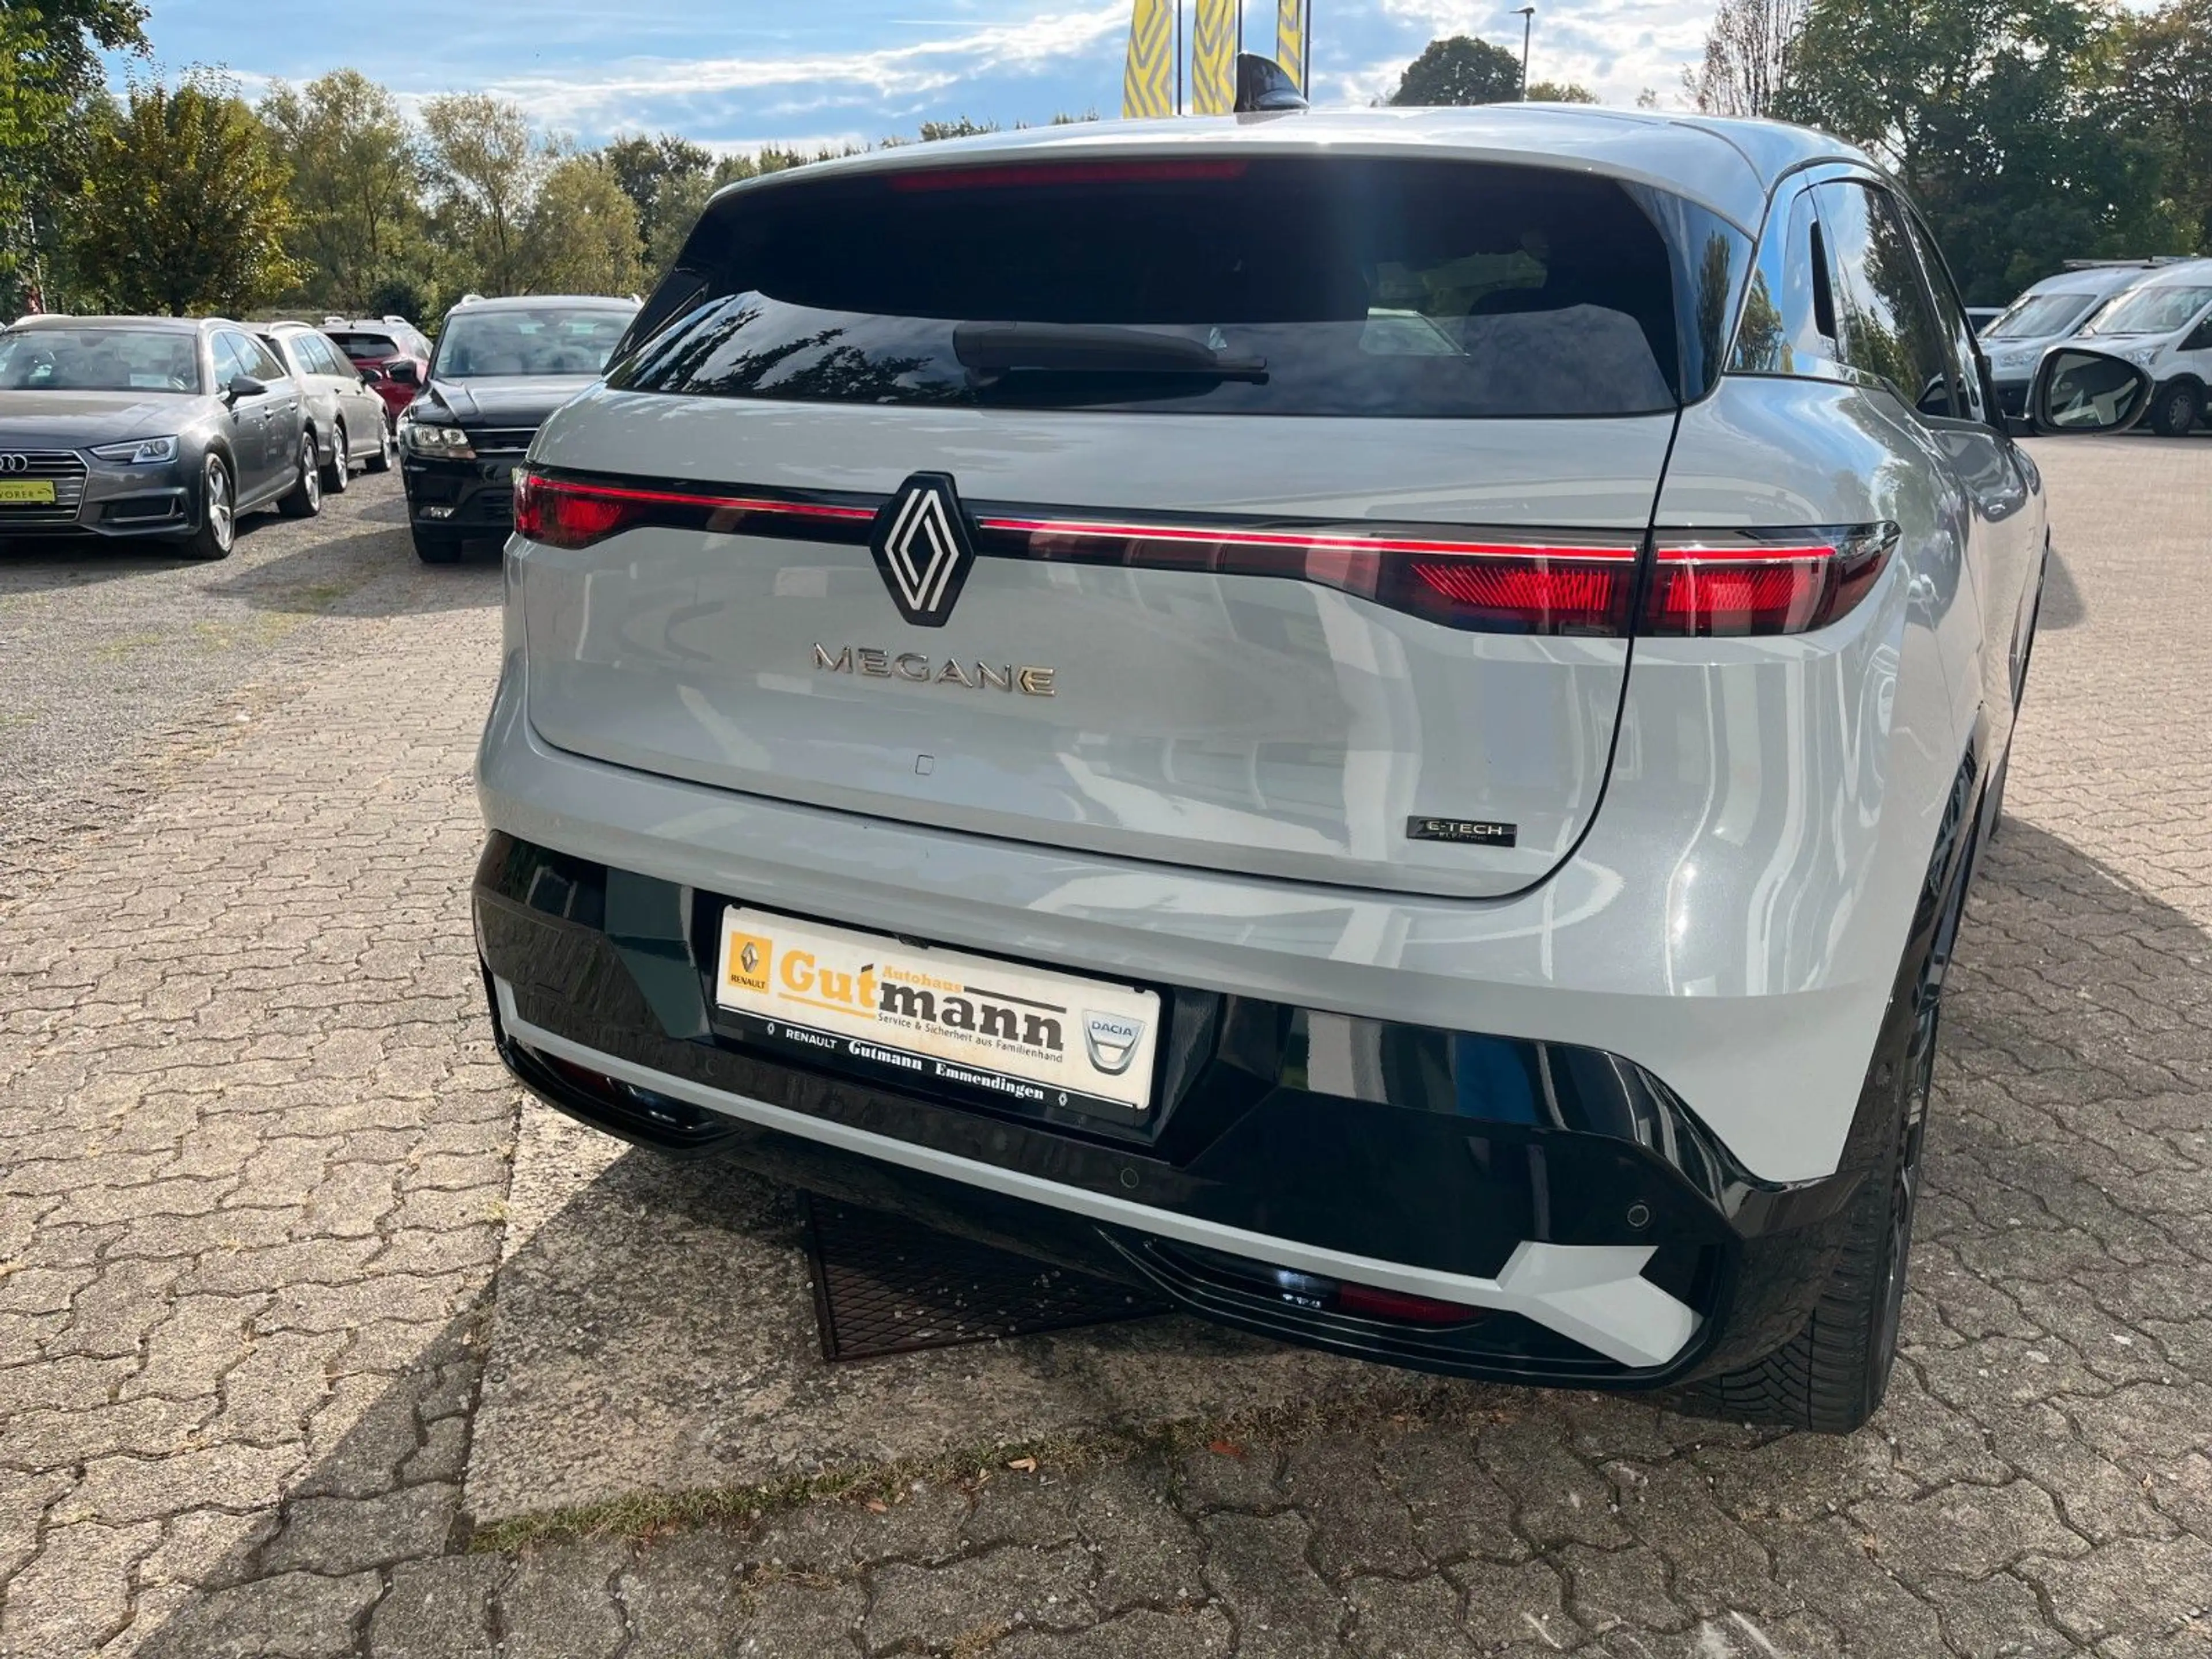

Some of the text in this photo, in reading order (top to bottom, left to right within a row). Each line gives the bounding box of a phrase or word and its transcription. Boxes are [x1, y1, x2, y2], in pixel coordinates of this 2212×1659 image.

[813, 642, 1056, 696] MEGANE
[730, 974, 766, 989] RENAULT
[779, 949, 1064, 1051] Gutmann
[882, 964, 962, 994] Autohaus
[877, 1012, 1063, 1063] Service & Sicherheit aus Familienhand
[1092, 1020, 1132, 1036] DACIA
[786, 1028, 1044, 1100] RENAULT Gutmann Emmendingen
